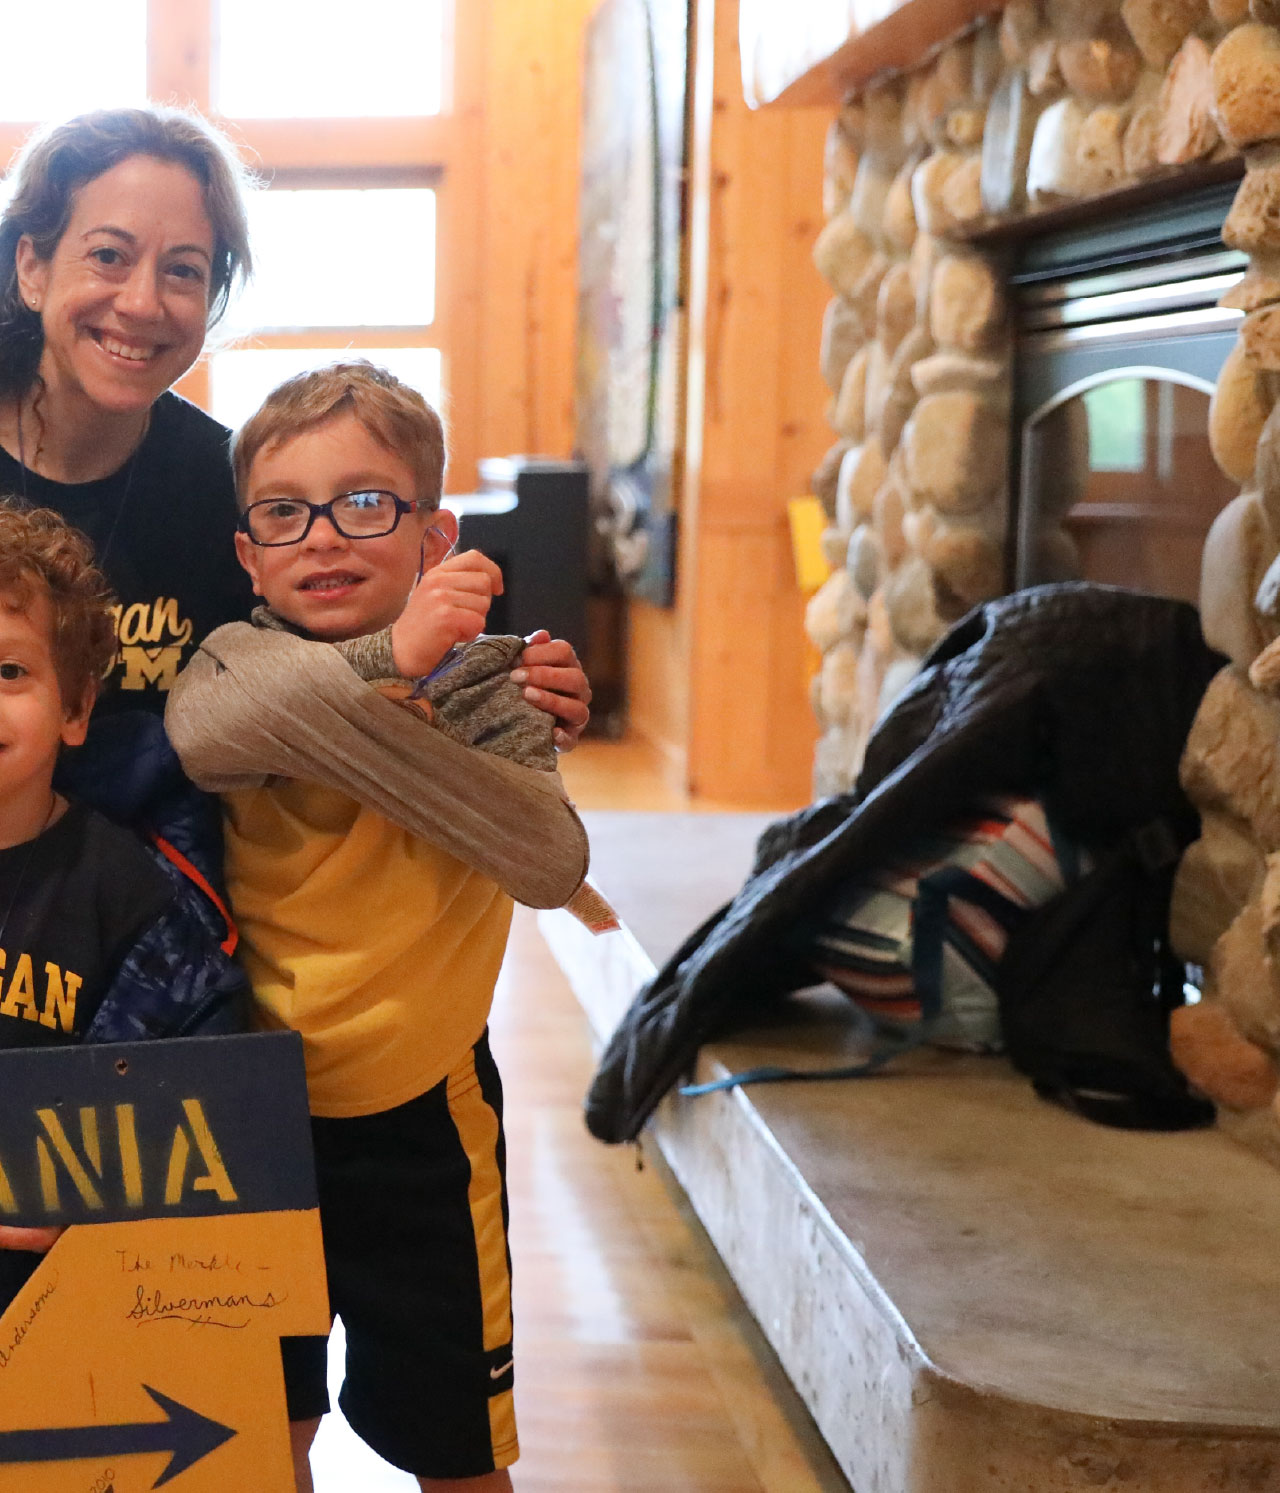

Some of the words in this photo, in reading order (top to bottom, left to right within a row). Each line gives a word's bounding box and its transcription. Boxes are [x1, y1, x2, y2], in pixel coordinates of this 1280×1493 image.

[121, 647, 182, 691] M
[116, 1250, 151, 1272] The
[126, 1285, 289, 1319] Silvermans
